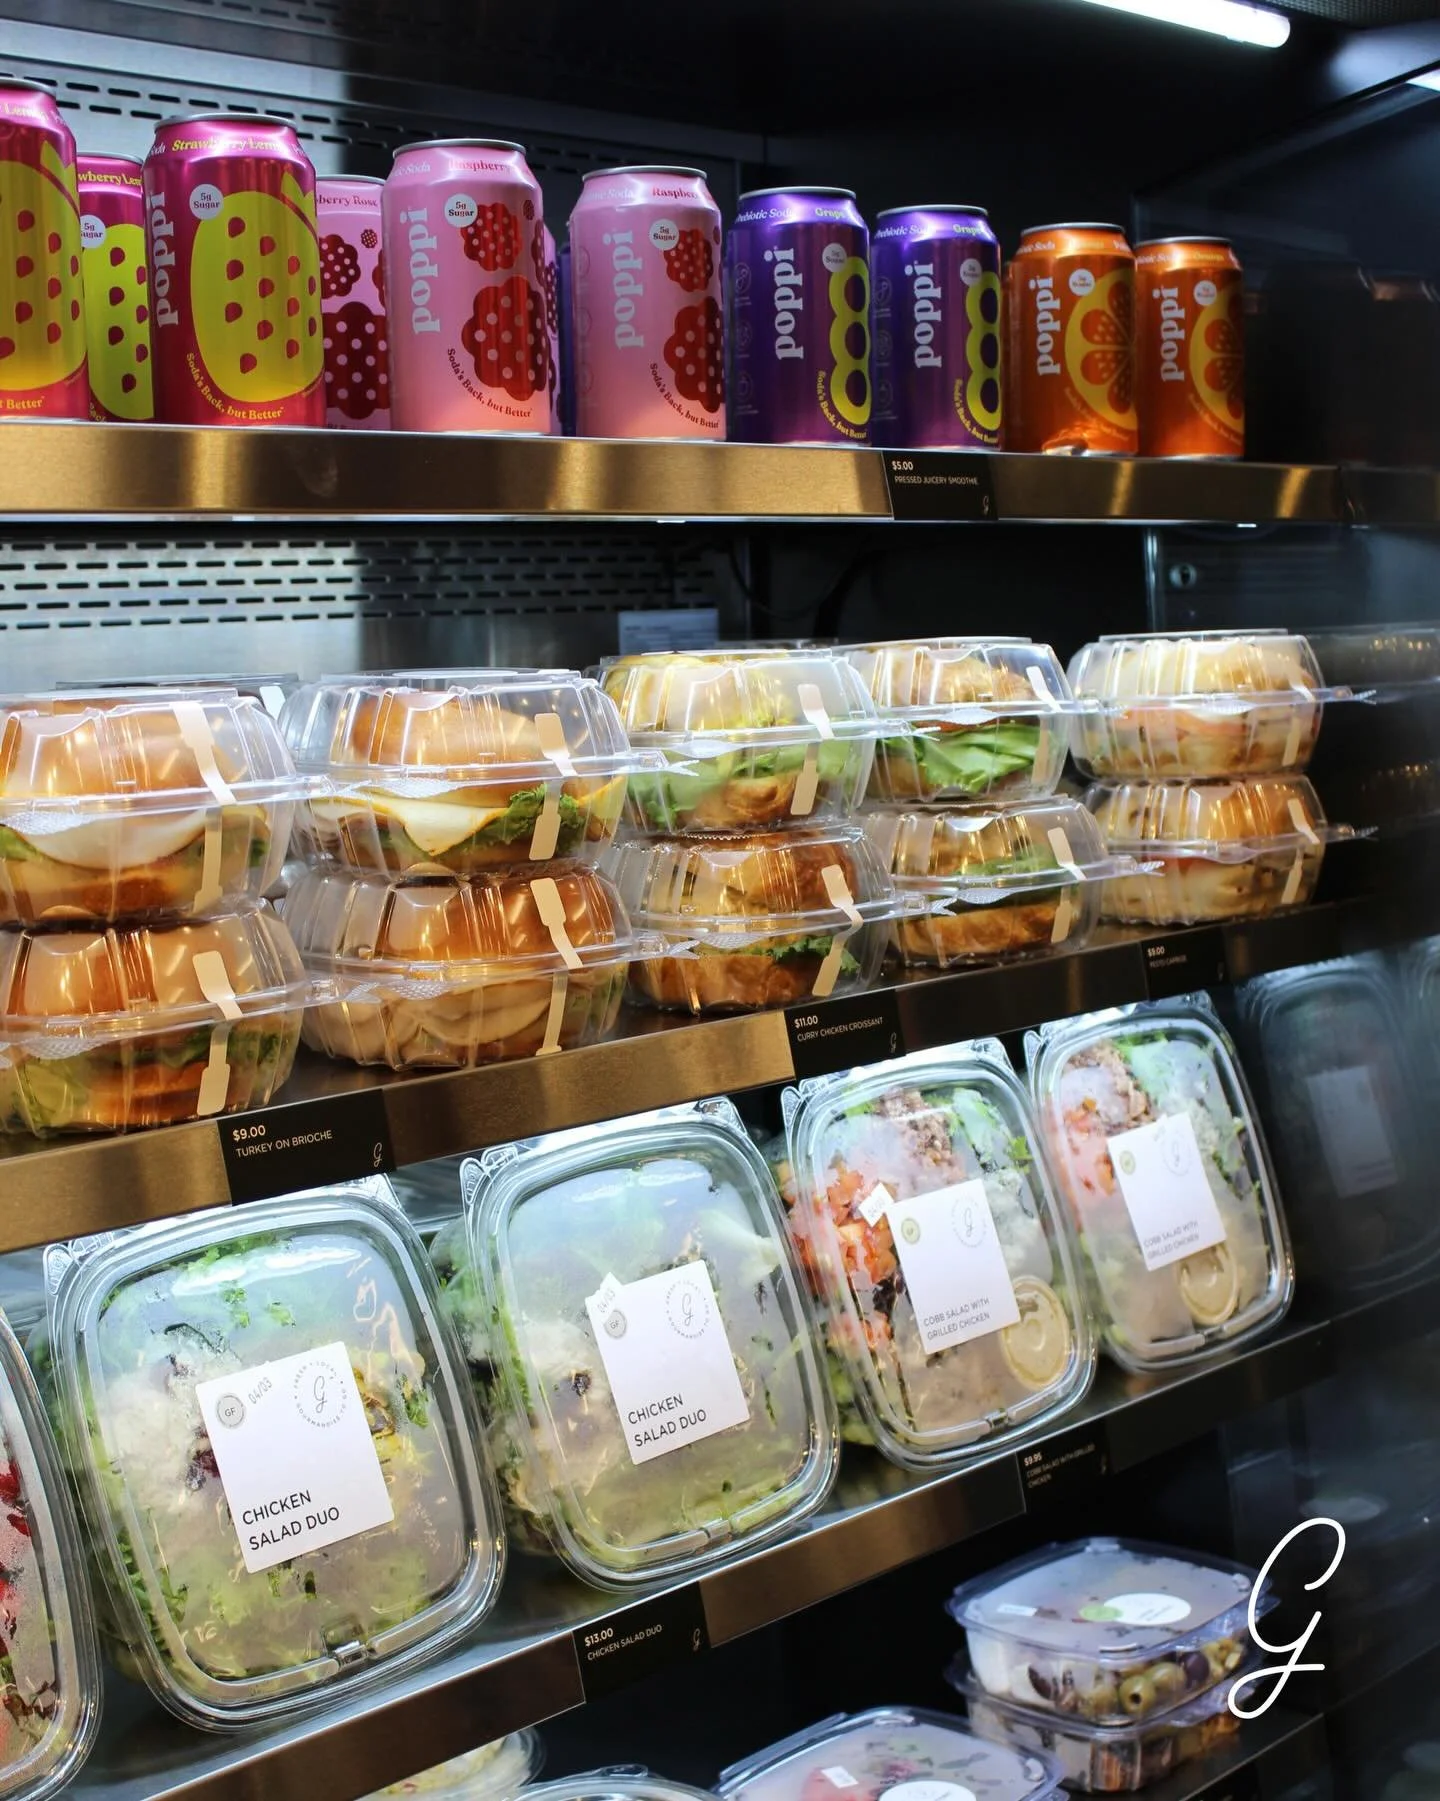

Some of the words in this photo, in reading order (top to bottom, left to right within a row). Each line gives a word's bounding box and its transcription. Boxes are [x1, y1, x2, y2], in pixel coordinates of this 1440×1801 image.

[193, 201, 221, 210] Sugar
[201, 193, 212, 202] 5g
[352, 195, 378, 207] Rose
[456, 200, 468, 210] 5g
[84, 222, 95, 231] 5g
[448, 209, 475, 218] Sugar
[80, 231, 103, 239] ugar
[150, 191, 179, 328] poppi
[400, 206, 441, 335] poppi
[603, 230, 645, 350] poppi
[764, 247, 804, 360] poppi
[904, 260, 942, 368] poppi
[1029, 275, 1061, 376] poppi
[1153, 286, 1186, 381] poppi
[462, 379, 485, 405] Back,
[486, 399, 503, 413] but
[227, 405, 248, 419] but
[685, 410, 699, 424] but
[892, 460, 914, 471] $5.00
[894, 476, 922, 484] PRESSED
[794, 1015, 819, 1029] $11.00
[797, 1030, 819, 1042] CURRY
[820, 1024, 848, 1037] CHICKEN
[849, 1016, 883, 1031] CROISSANT
[232, 1124, 266, 1142] $9.00
[235, 1141, 273, 1158] TURKEY
[275, 1138, 290, 1150] ON
[292, 1129, 333, 1147] BRIOCHE
[923, 1312, 945, 1327] COBB
[946, 1303, 970, 1319] SALAD
[970, 1297, 990, 1310] WITH
[927, 1322, 958, 1341] GRILLED
[959, 1312, 990, 1329] CHICKEN
[225, 1407, 236, 1417] GF
[627, 1393, 684, 1425] CHICKEN
[634, 1421, 676, 1447] SALAD
[679, 1409, 707, 1429] DUO
[242, 1488, 312, 1525] CHICKEN
[248, 1520, 302, 1551] SALAD
[305, 1506, 340, 1531] DUO
[584, 1627, 614, 1646] $13.00
[587, 1642, 620, 1661] CHICKEN
[620, 1631, 645, 1648] SALAD
[646, 1624, 663, 1637] DUO
